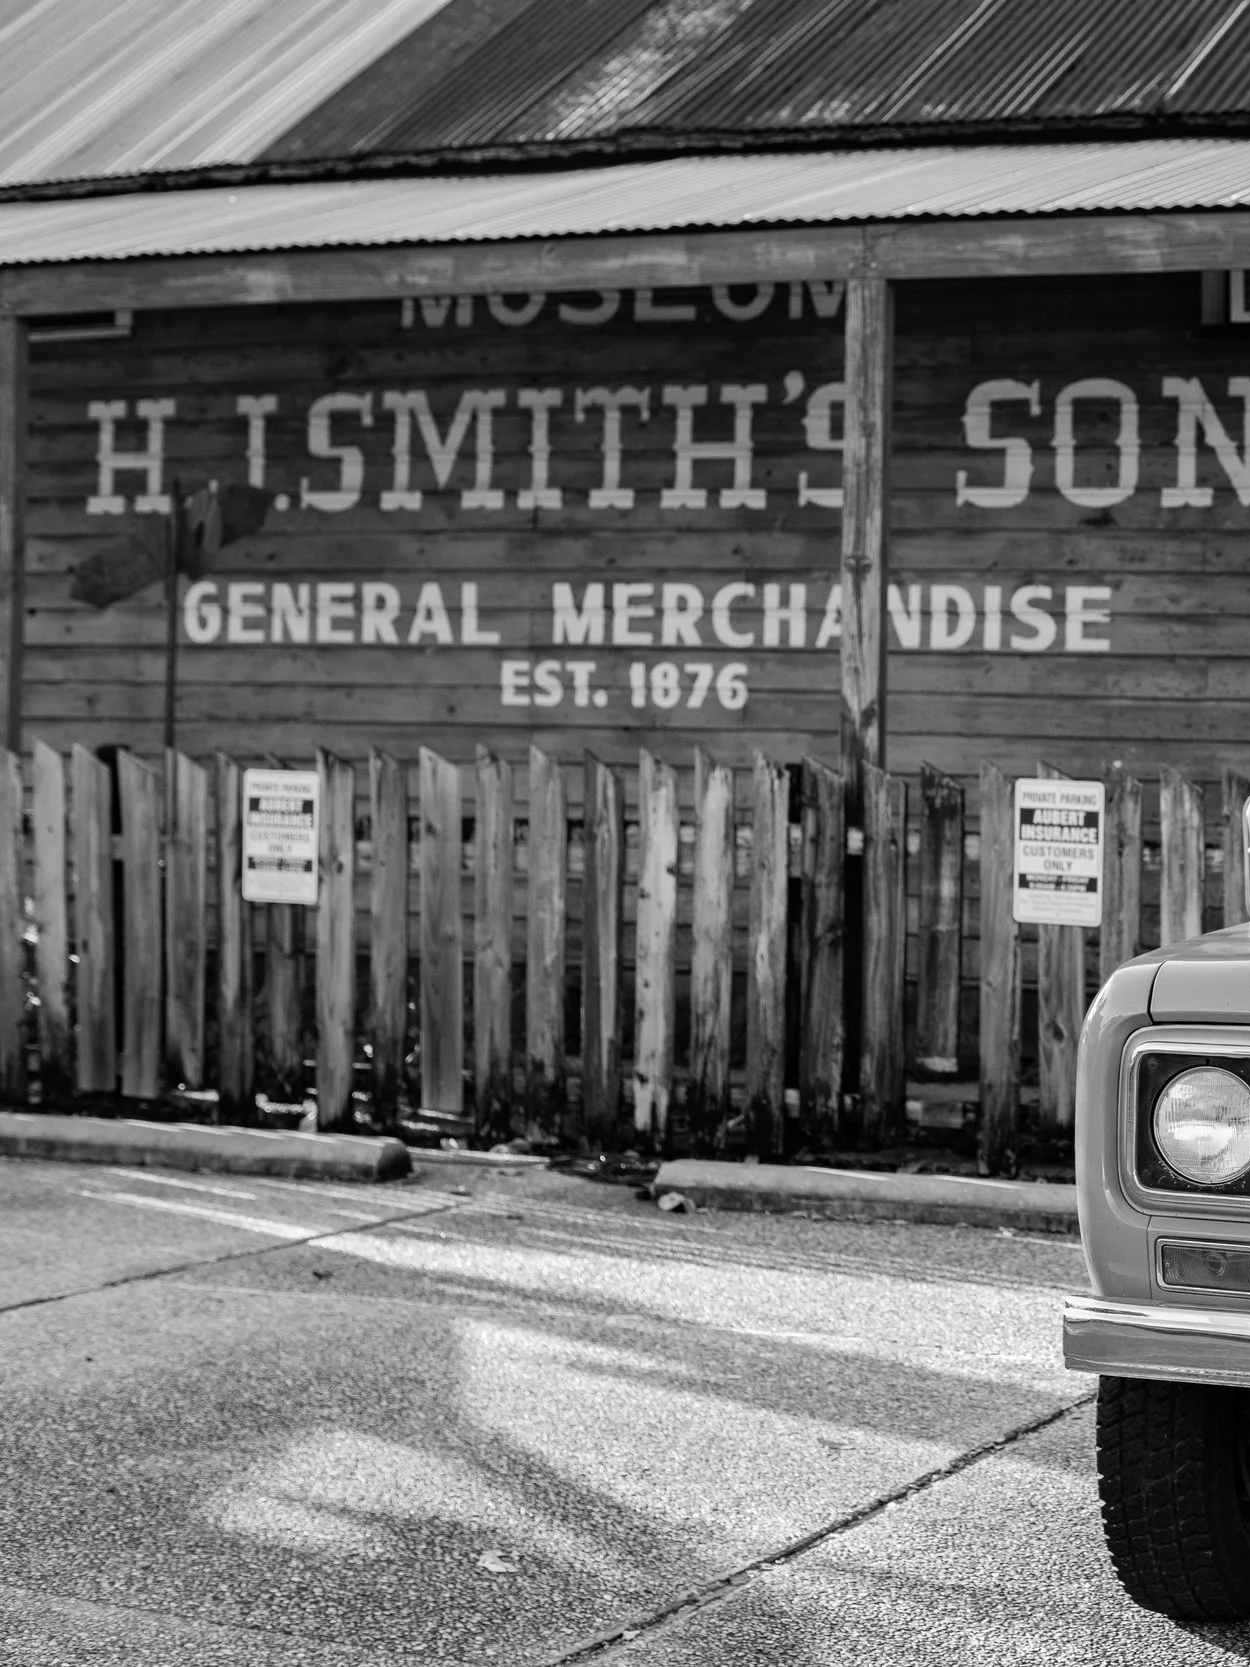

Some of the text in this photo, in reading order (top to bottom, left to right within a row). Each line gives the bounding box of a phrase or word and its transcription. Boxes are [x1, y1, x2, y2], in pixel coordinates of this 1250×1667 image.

[183, 581, 1112, 652] GENERAL MERCHANDISE
[501, 660, 749, 710] EST. 1876
[1022, 790, 1098, 806] PRIVATE PARKING
[1032, 808, 1086, 826] AUBERT
[1021, 823, 1098, 843] INSURANCE
[1022, 844, 1095, 860] CUSTOMERS
[1043, 858, 1073, 873] ONLY
